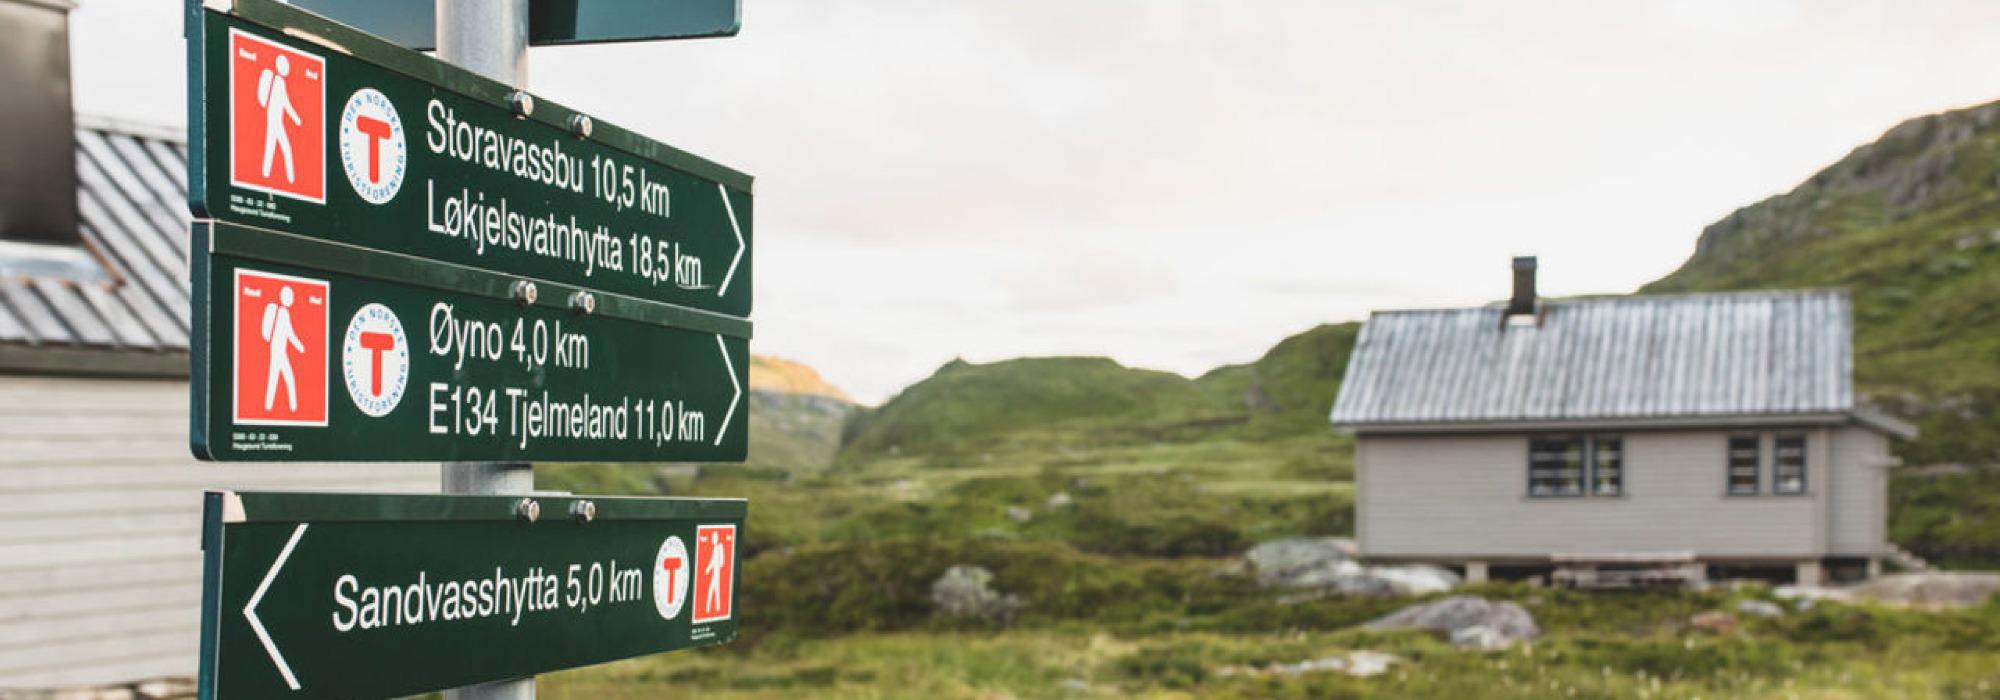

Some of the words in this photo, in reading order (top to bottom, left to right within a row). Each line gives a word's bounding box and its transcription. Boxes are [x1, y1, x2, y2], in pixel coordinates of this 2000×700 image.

[356, 114, 392, 185] T
[427, 98, 584, 193] Storavassbu
[591, 153, 635, 212] 10,5
[640, 167, 670, 218] km
[427, 178, 624, 277] Løkjelsvatnhytta
[628, 232, 670, 286] 18,5
[674, 241, 701, 288] km
[360, 331, 395, 397] T
[429, 301, 504, 371] Øyno
[510, 317, 548, 372] 4,0
[555, 319, 589, 369] km
[428, 381, 499, 437] E134
[505, 387, 629, 451] Tjelmeland
[634, 398, 674, 447] 11,0
[677, 400, 704, 442] km
[332, 566, 559, 632] Sandvasshytta
[566, 561, 604, 614] 5,0
[608, 559, 643, 603] km
